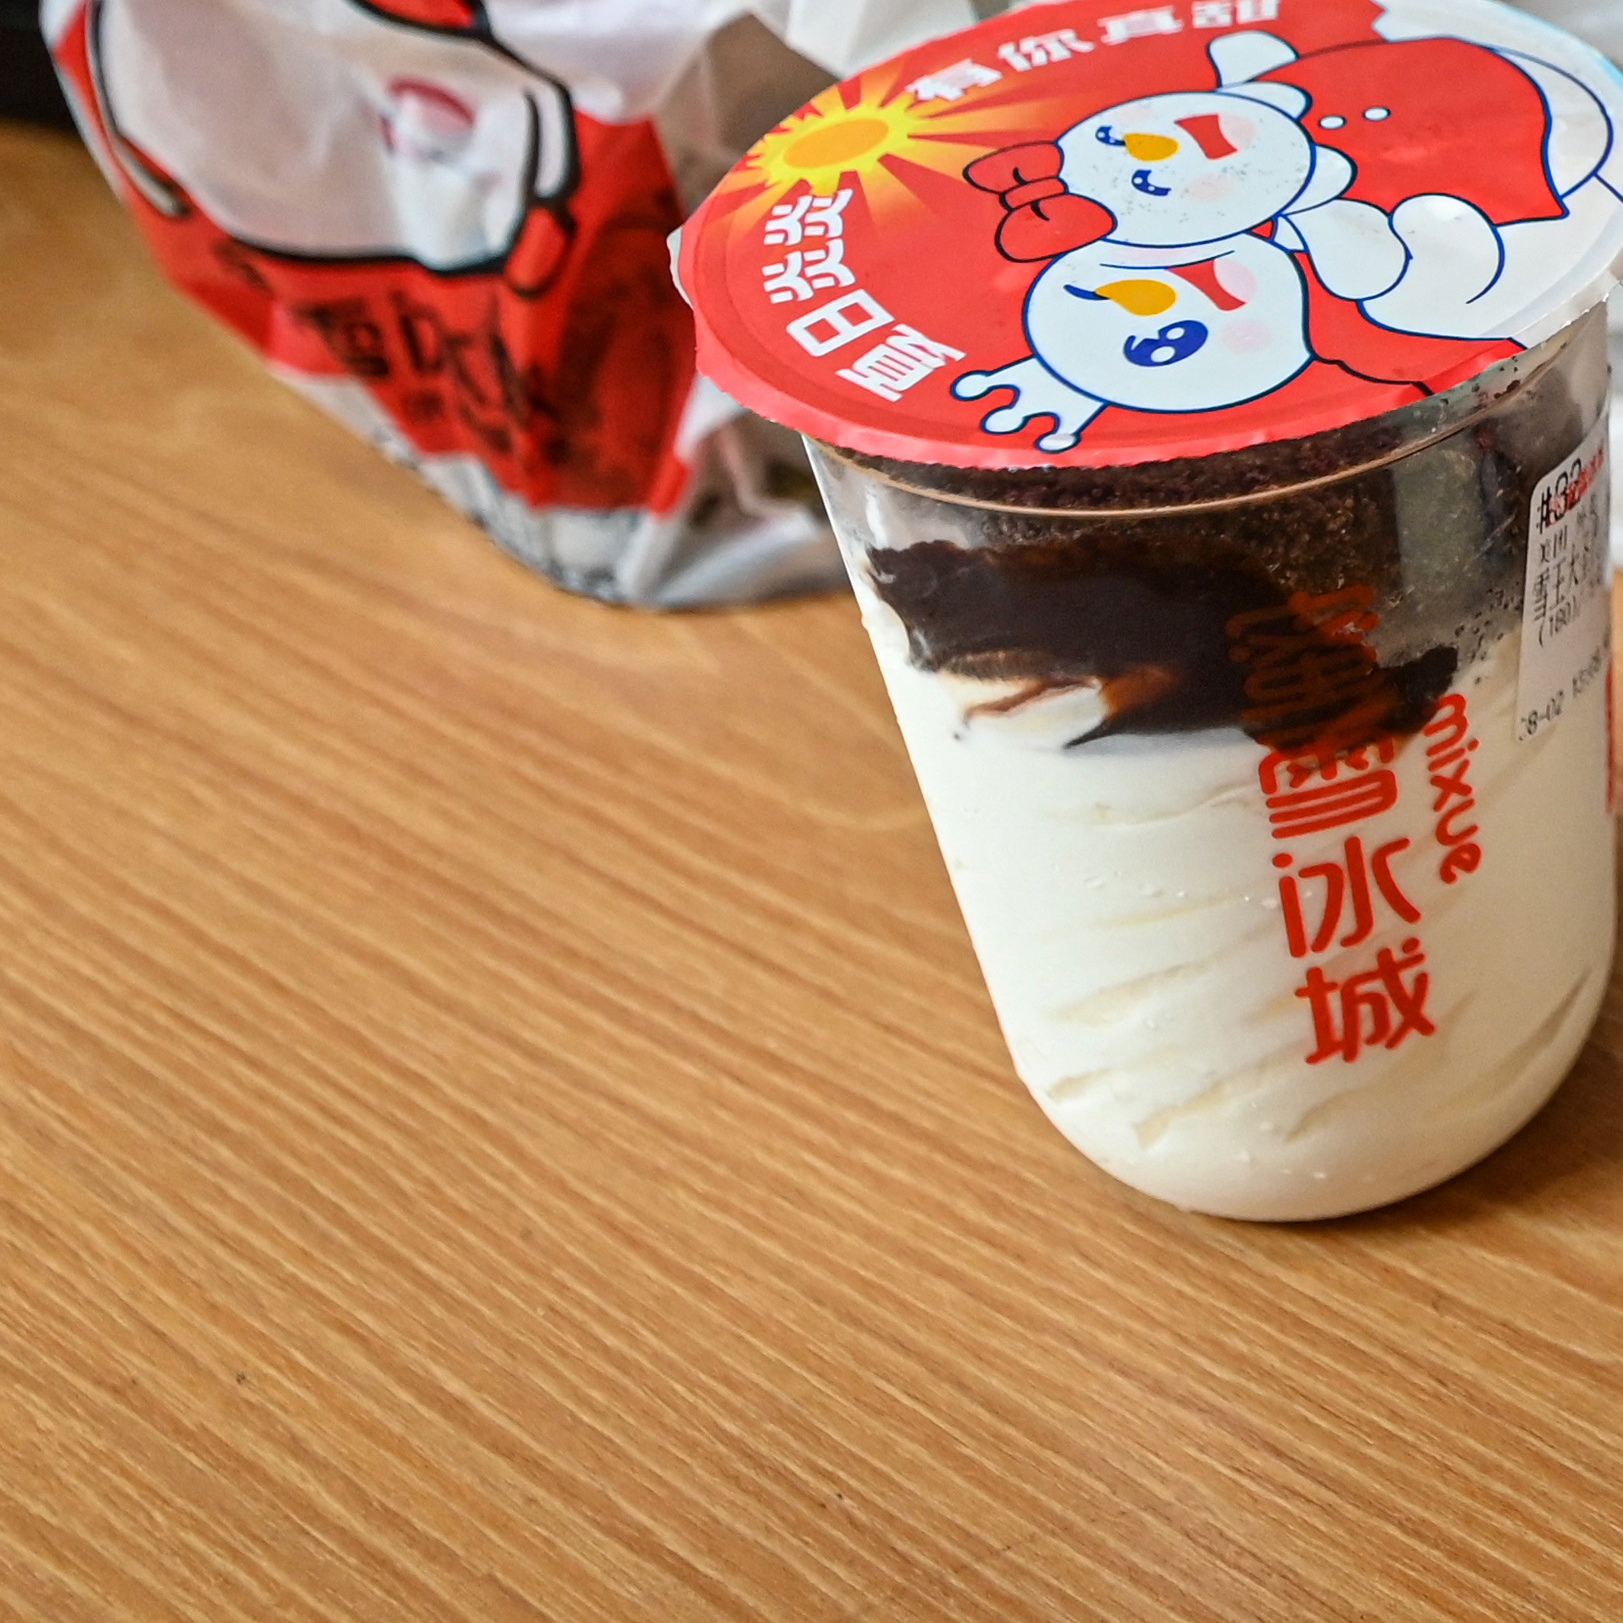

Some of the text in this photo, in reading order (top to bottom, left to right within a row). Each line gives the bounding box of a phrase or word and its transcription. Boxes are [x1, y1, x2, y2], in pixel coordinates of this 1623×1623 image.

[761, 186, 966, 400] 夏日炎炎
[1423, 693, 1482, 884] mixue
